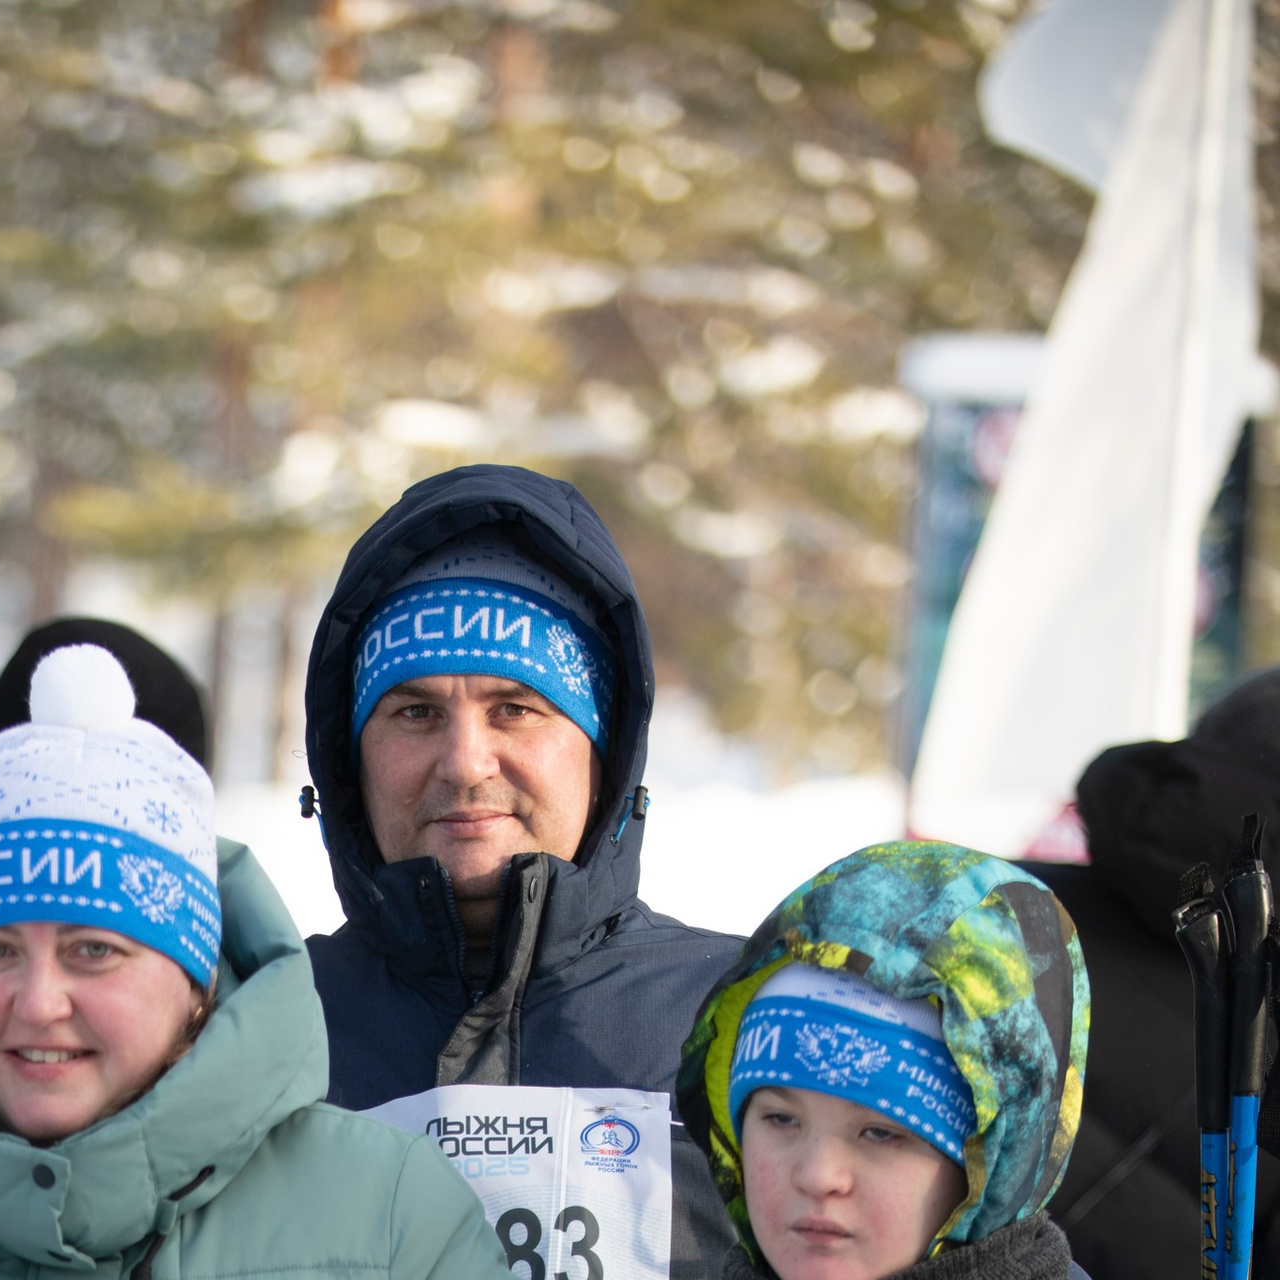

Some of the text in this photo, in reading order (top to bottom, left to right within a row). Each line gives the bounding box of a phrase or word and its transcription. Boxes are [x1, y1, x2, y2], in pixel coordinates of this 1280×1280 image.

[897, 1060, 976, 1120] МИНСПО
[425, 1115, 548, 1137] ЛЫЖНЯ
[438, 1136, 554, 1158] ОССИИ
